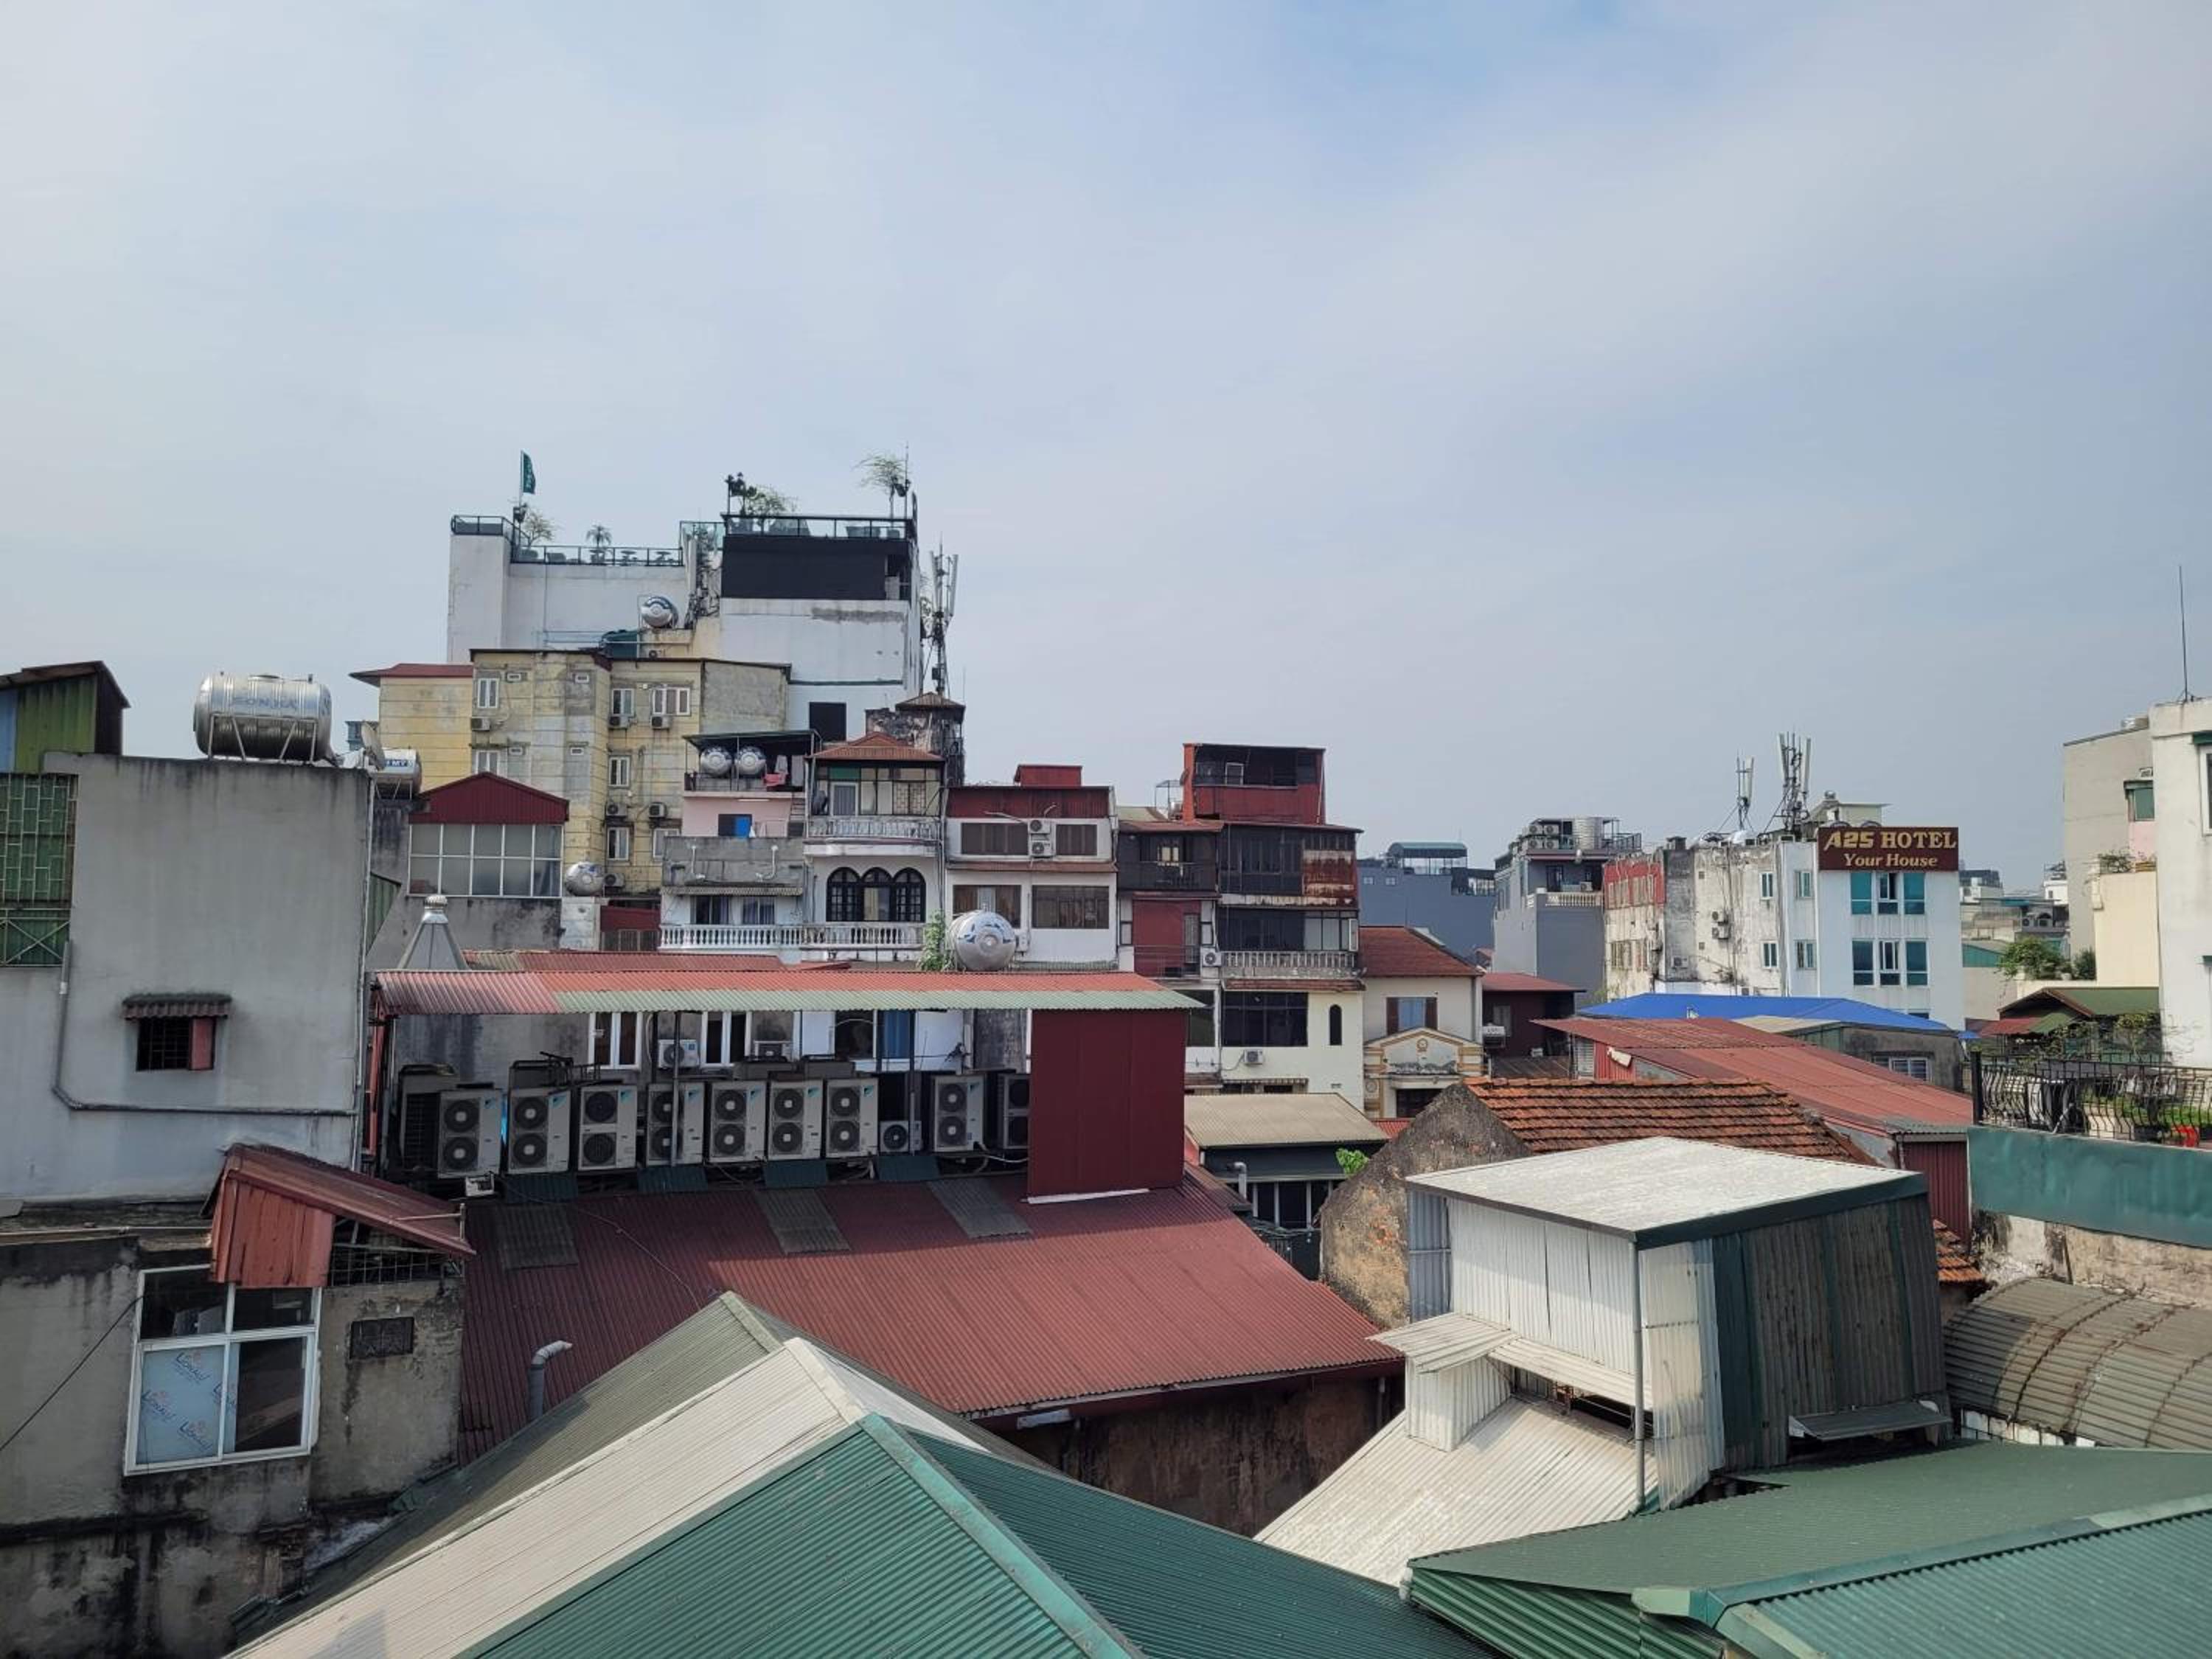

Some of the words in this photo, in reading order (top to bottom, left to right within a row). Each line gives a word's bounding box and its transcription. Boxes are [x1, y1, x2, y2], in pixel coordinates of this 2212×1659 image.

[1823, 830, 1874, 851] A25
[1880, 831, 1957, 849] HOTEL
[1843, 853, 1883, 866] Your
[1885, 853, 1938, 866] House
